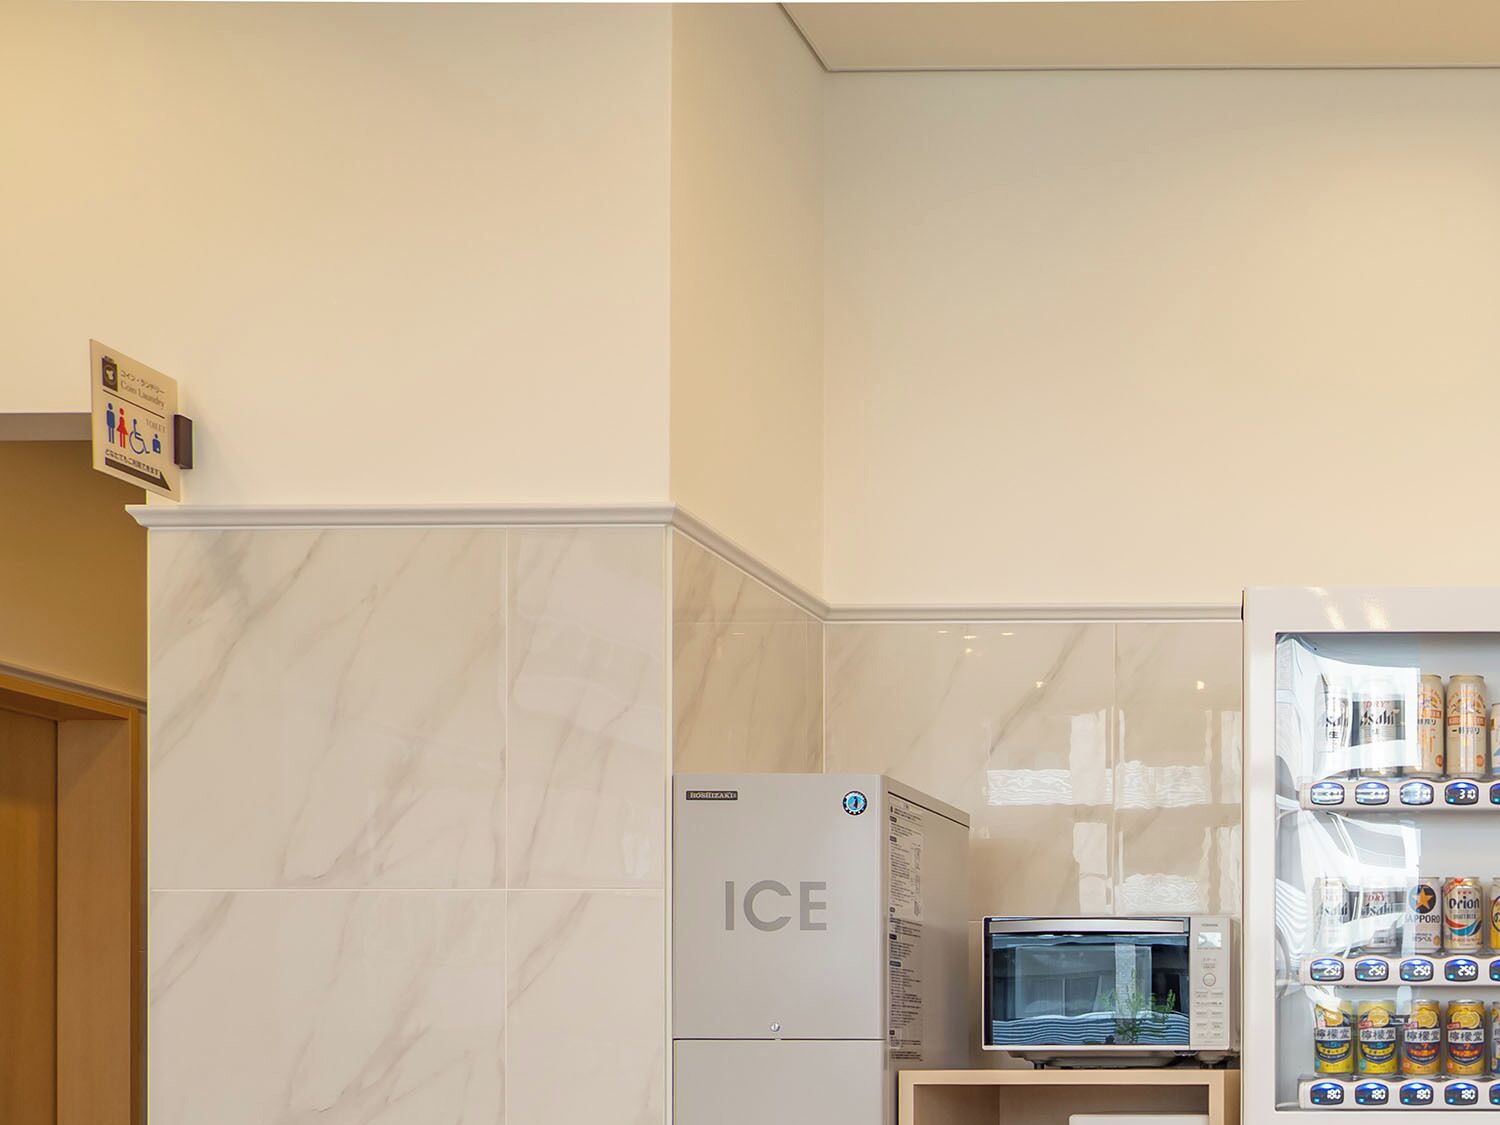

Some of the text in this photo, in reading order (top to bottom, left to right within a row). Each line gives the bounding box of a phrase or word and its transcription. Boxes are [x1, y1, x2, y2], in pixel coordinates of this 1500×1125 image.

[1459, 788, 1476, 800] 310
[725, 879, 827, 932] ICE
[1448, 895, 1480, 910] Orion
[1368, 965, 1386, 976] 250
[1413, 965, 1431, 976] 250
[1457, 965, 1476, 976] 250
